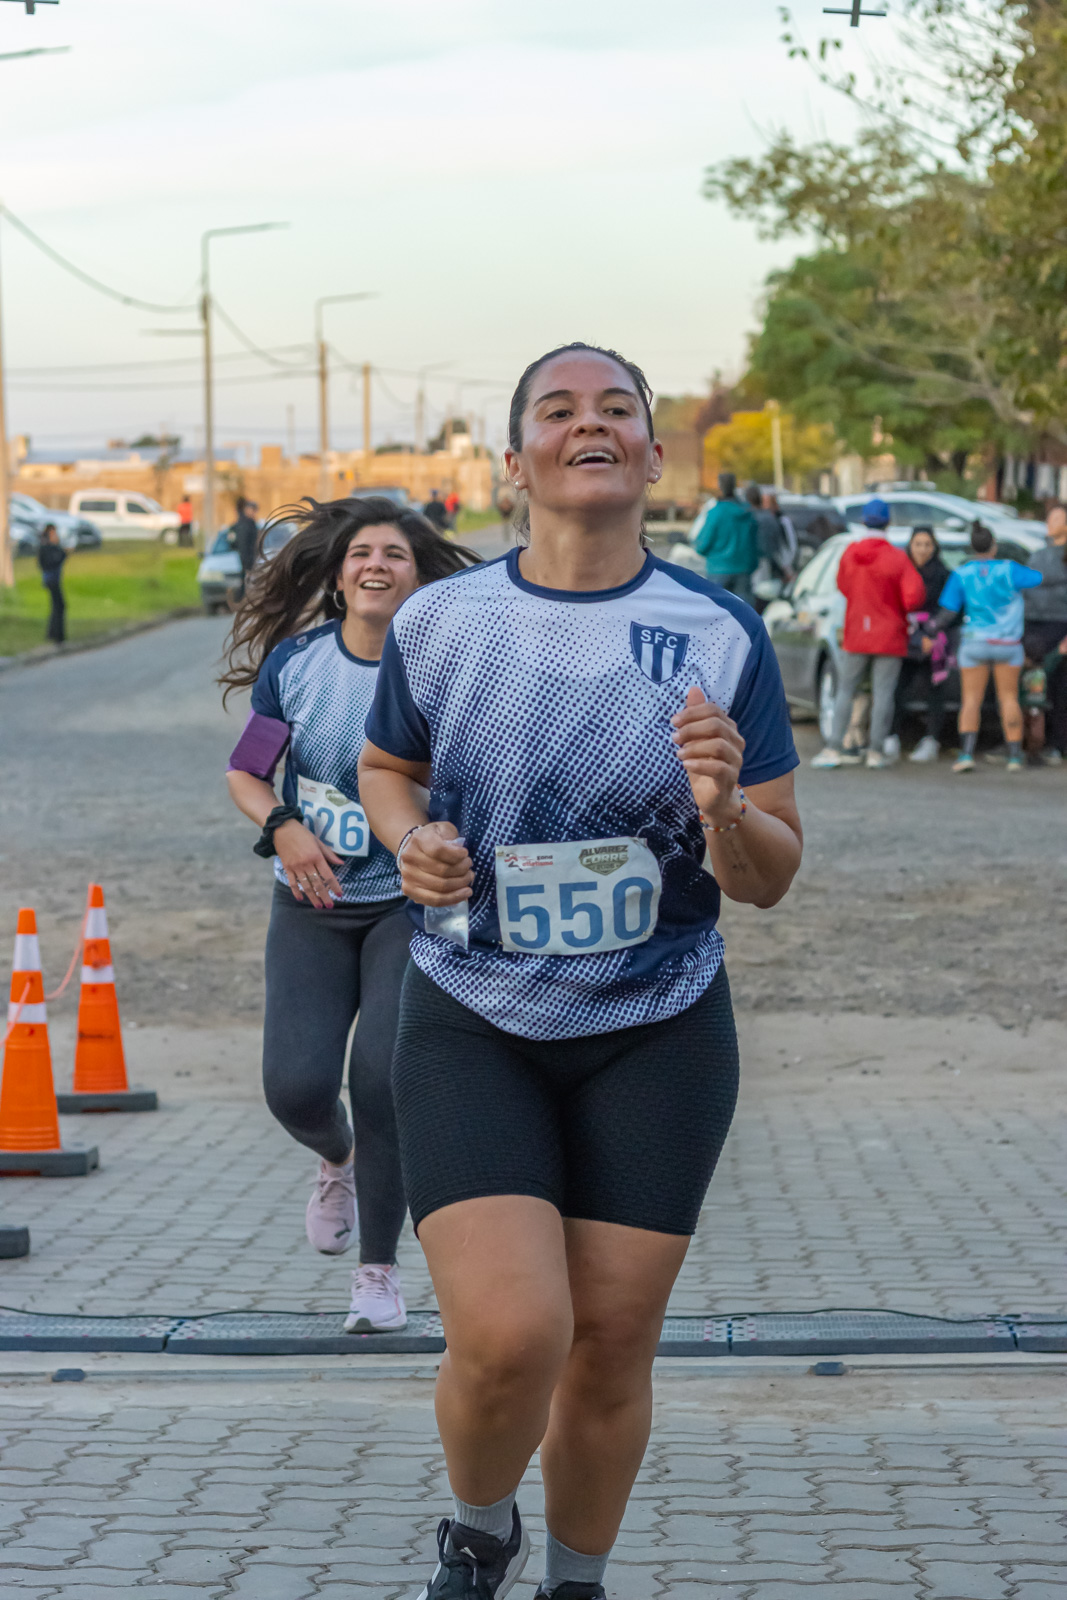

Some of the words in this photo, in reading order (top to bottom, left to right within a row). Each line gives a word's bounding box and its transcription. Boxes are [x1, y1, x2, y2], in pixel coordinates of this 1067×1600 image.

[640, 629, 678, 649] SFC
[301, 799, 364, 851] 526
[581, 845, 629, 856] ALVAREZ
[582, 851, 628, 866] CORRE
[505, 876, 654, 949] 550
